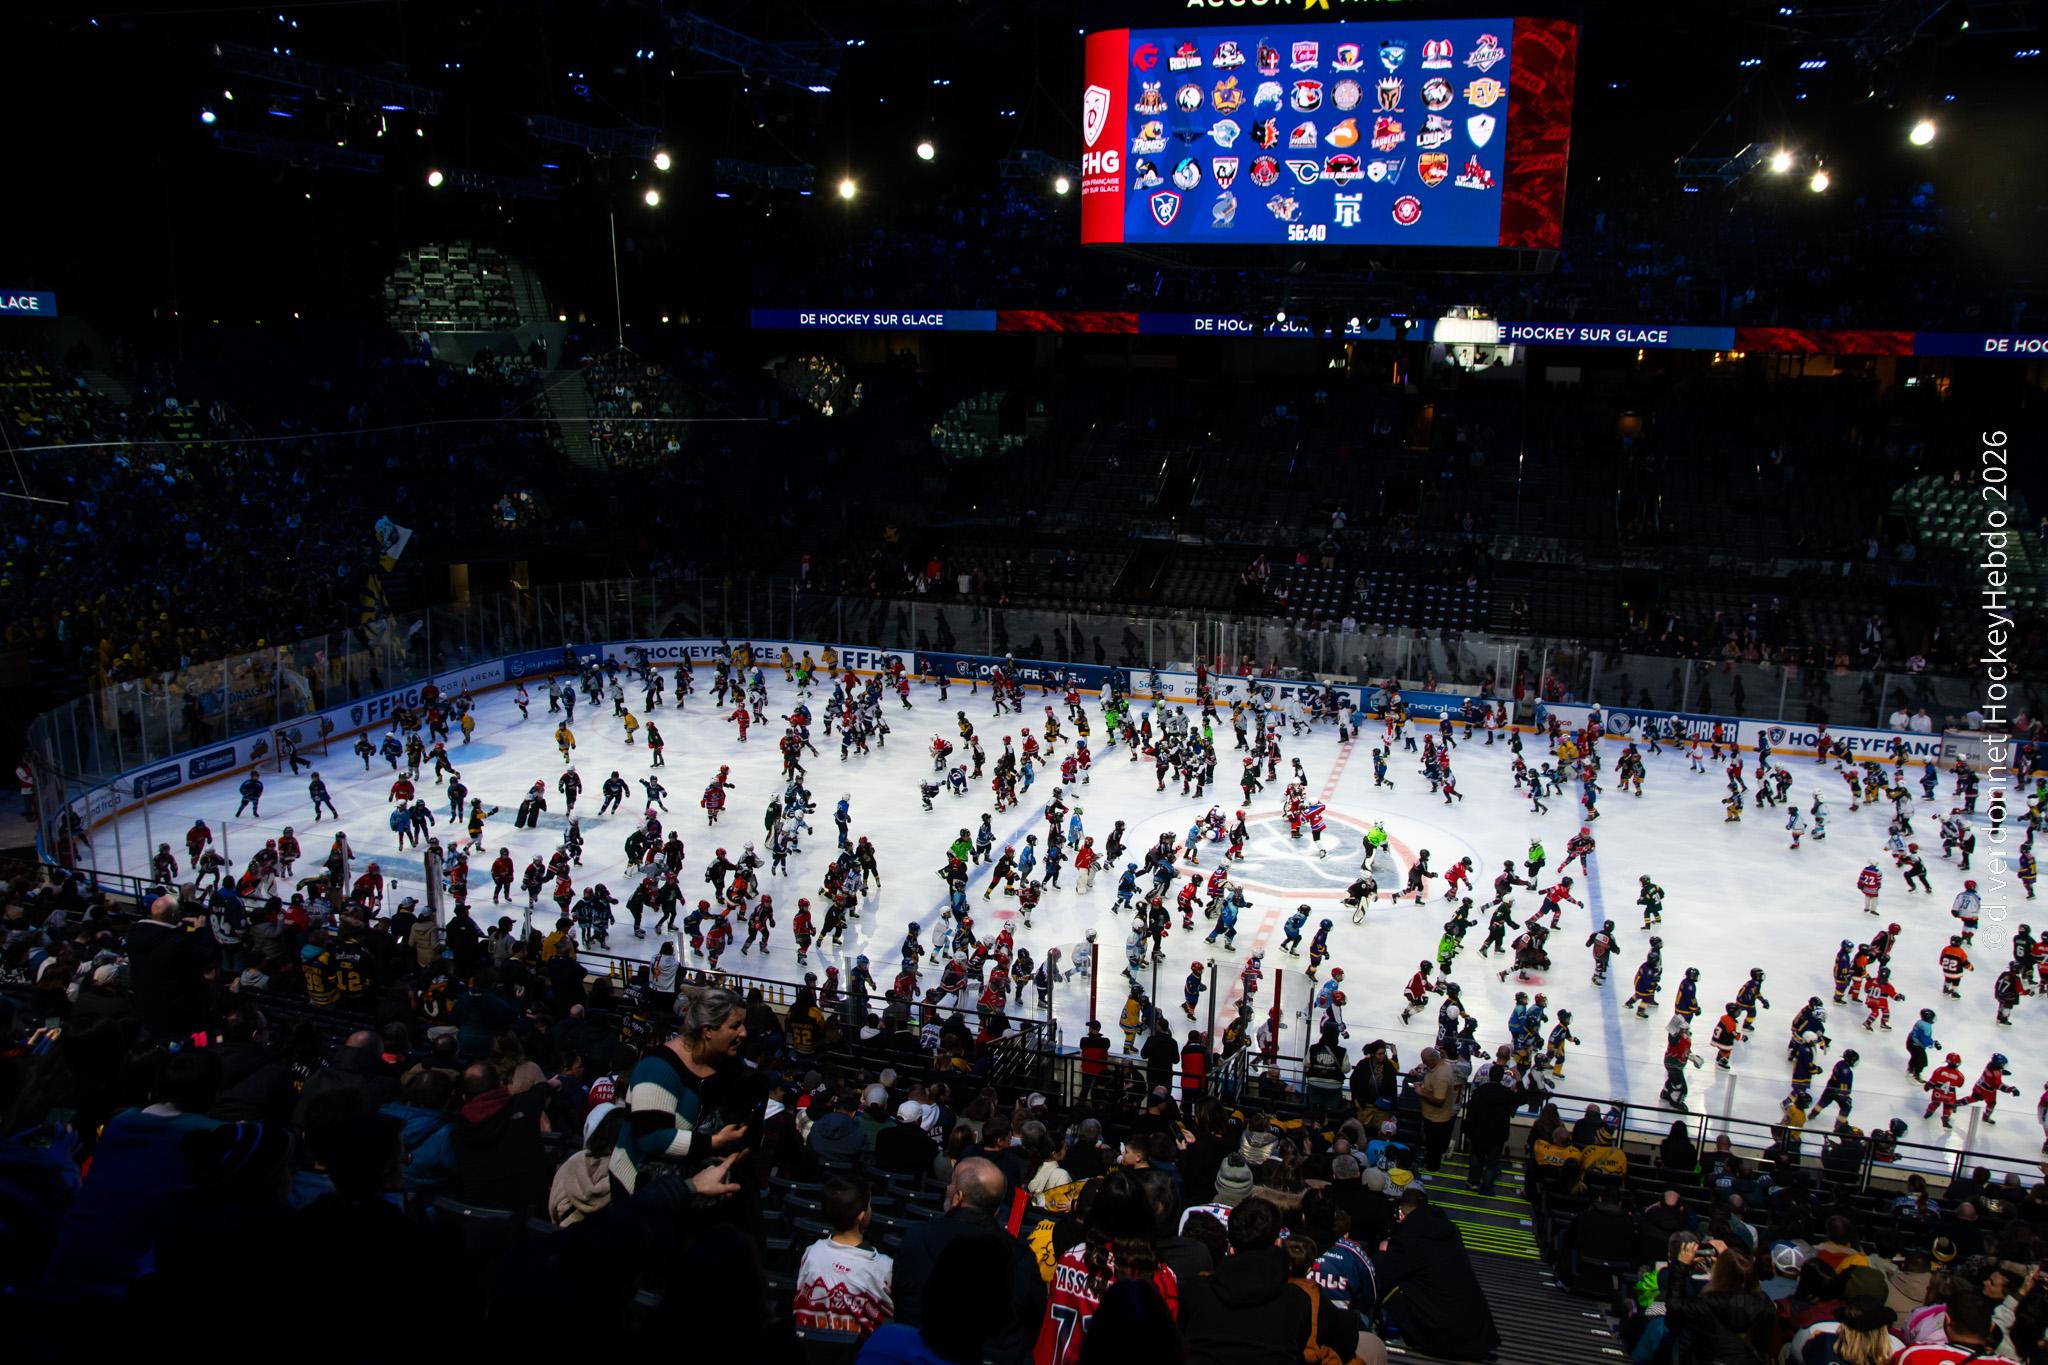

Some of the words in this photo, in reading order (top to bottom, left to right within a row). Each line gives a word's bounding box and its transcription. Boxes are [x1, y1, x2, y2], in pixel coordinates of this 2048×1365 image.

[1472, 49, 1502, 61] JOKERS
[1288, 223, 1326, 242] 56:40
[800, 314, 816, 325] DE
[819, 314, 870, 326] HOCKEY
[873, 314, 898, 326] SUR
[902, 314, 943, 326] GLACE
[1195, 318, 1213, 331] DE
[1511, 327, 1576, 340] HOCKEY
[1580, 328, 1611, 341] SUR
[1615, 329, 1668, 343] GLACE
[1985, 339, 2008, 352] DE
[1863, 875, 1876, 886] 22
[1942, 958, 1958, 971] 22
